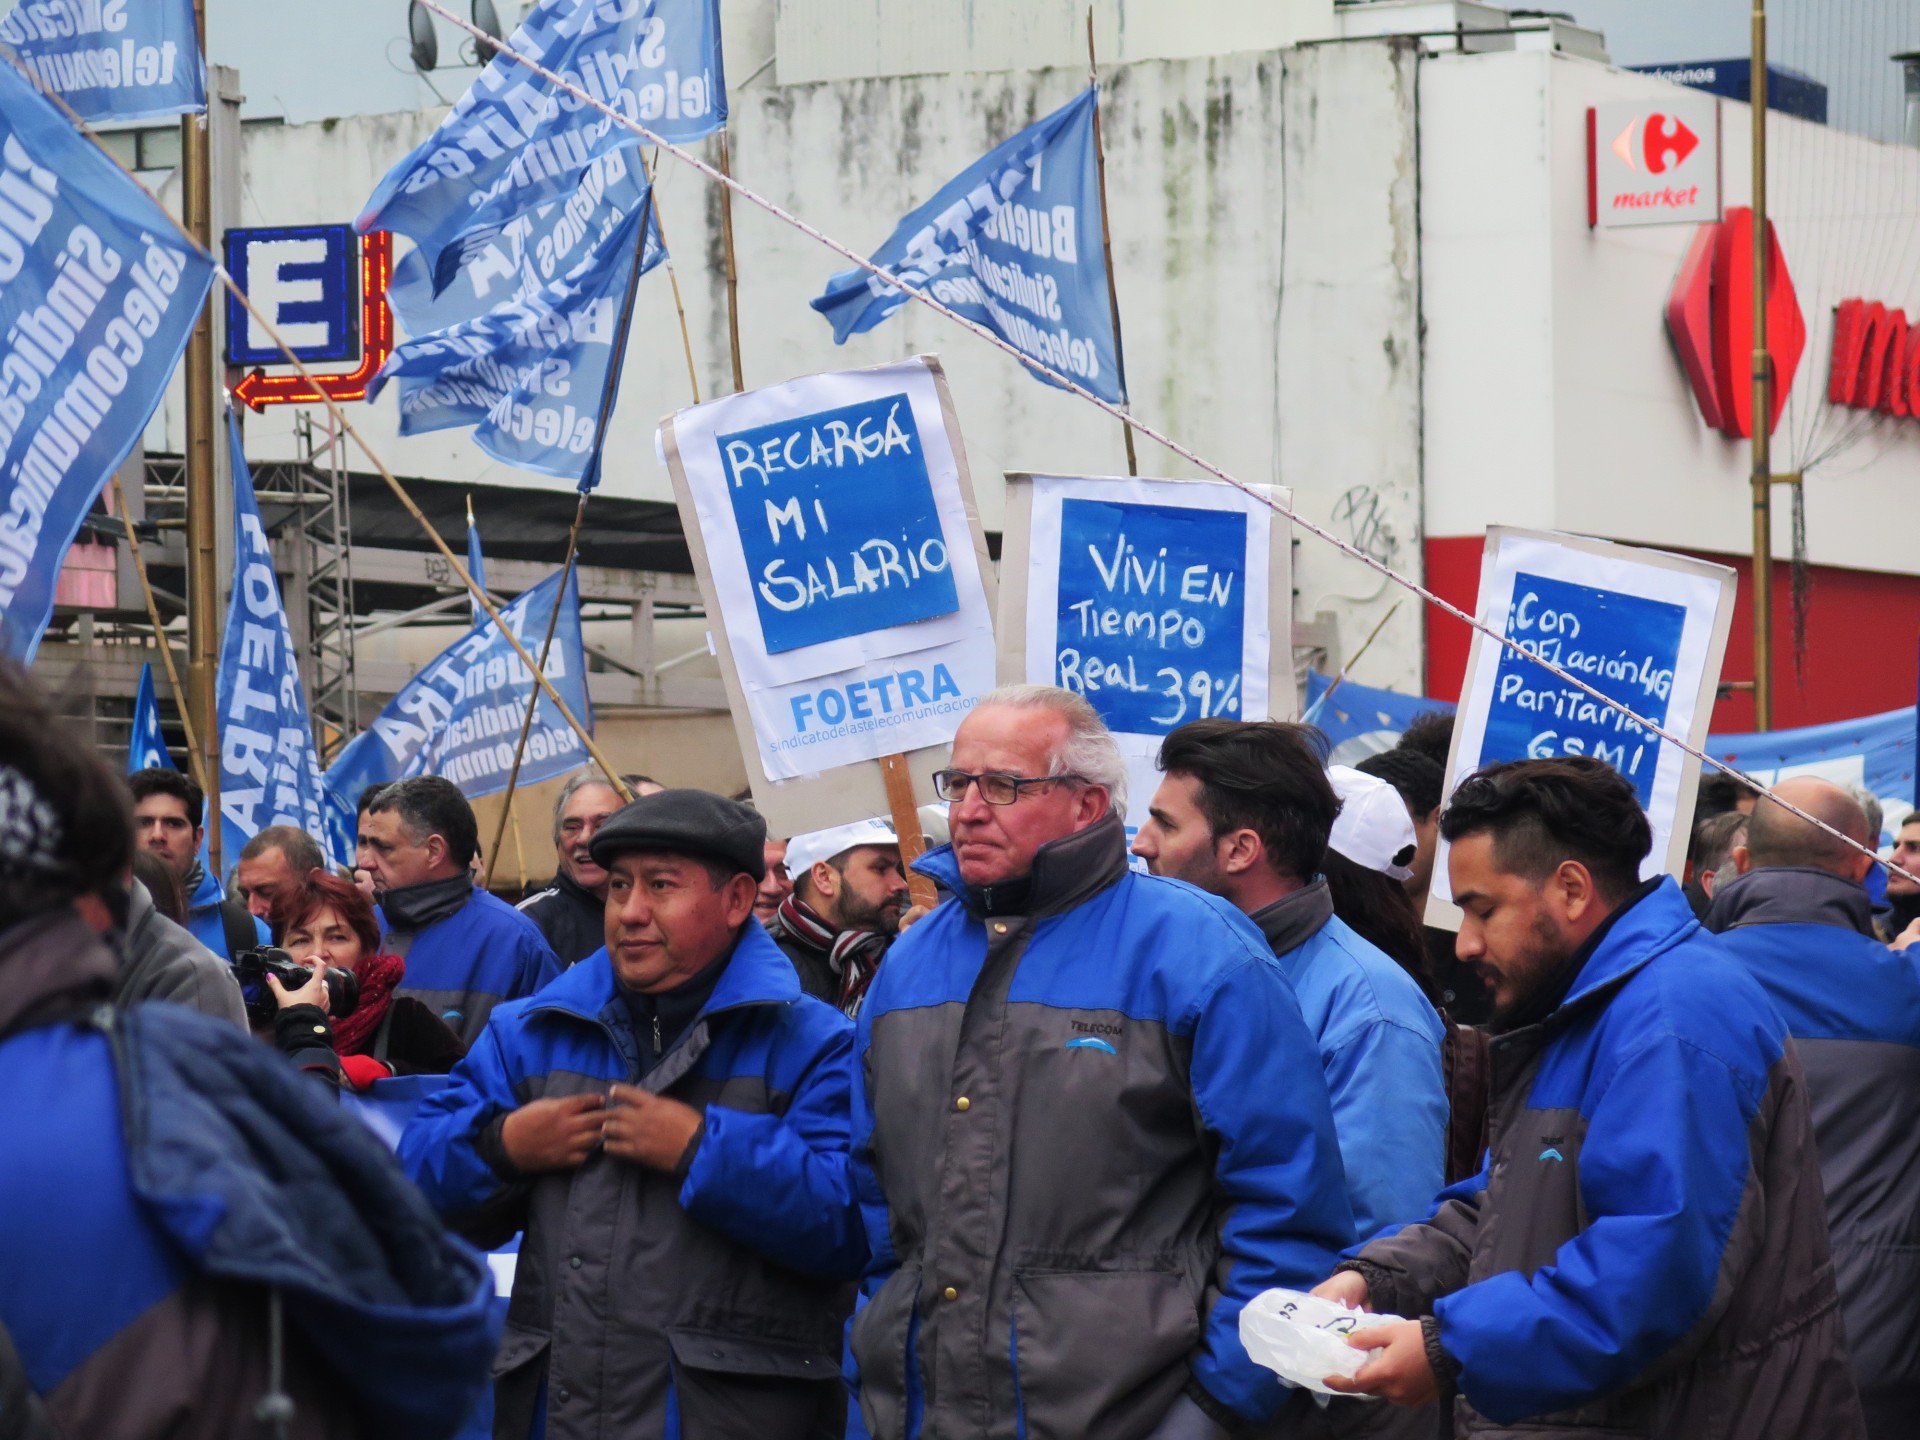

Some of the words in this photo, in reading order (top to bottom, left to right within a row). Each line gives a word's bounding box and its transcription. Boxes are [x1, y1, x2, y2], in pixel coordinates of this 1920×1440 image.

[1612, 184, 1699, 208] market
[247, 238, 329, 350] E
[725, 401, 911, 487] RECARGÁ
[1180, 564, 1233, 608] EN
[789, 662, 961, 733] FOETRA
[1150, 667, 1240, 725] 39%
[1071, 1020, 1123, 1036] TELECOM
